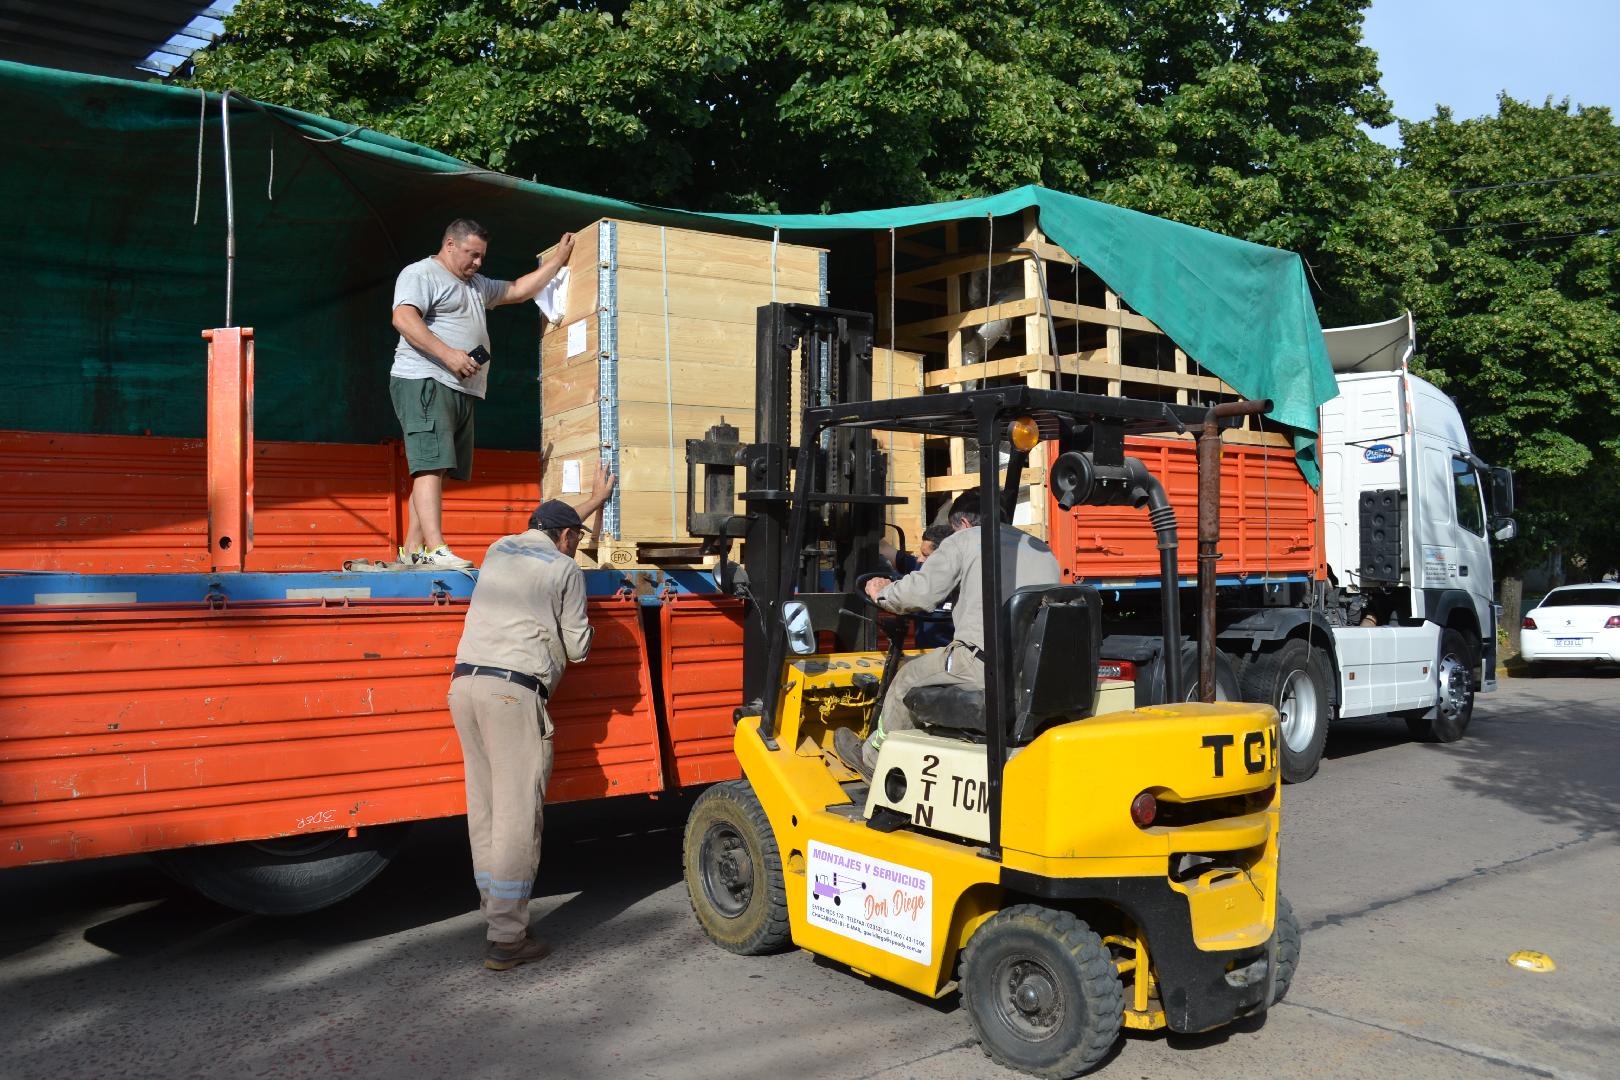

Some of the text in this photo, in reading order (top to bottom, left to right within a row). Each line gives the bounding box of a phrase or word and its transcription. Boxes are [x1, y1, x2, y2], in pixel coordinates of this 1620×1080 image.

[812, 848, 926, 891] MONTAJES Y SERVICIOS
[864, 889, 926, 922] Don Diego
